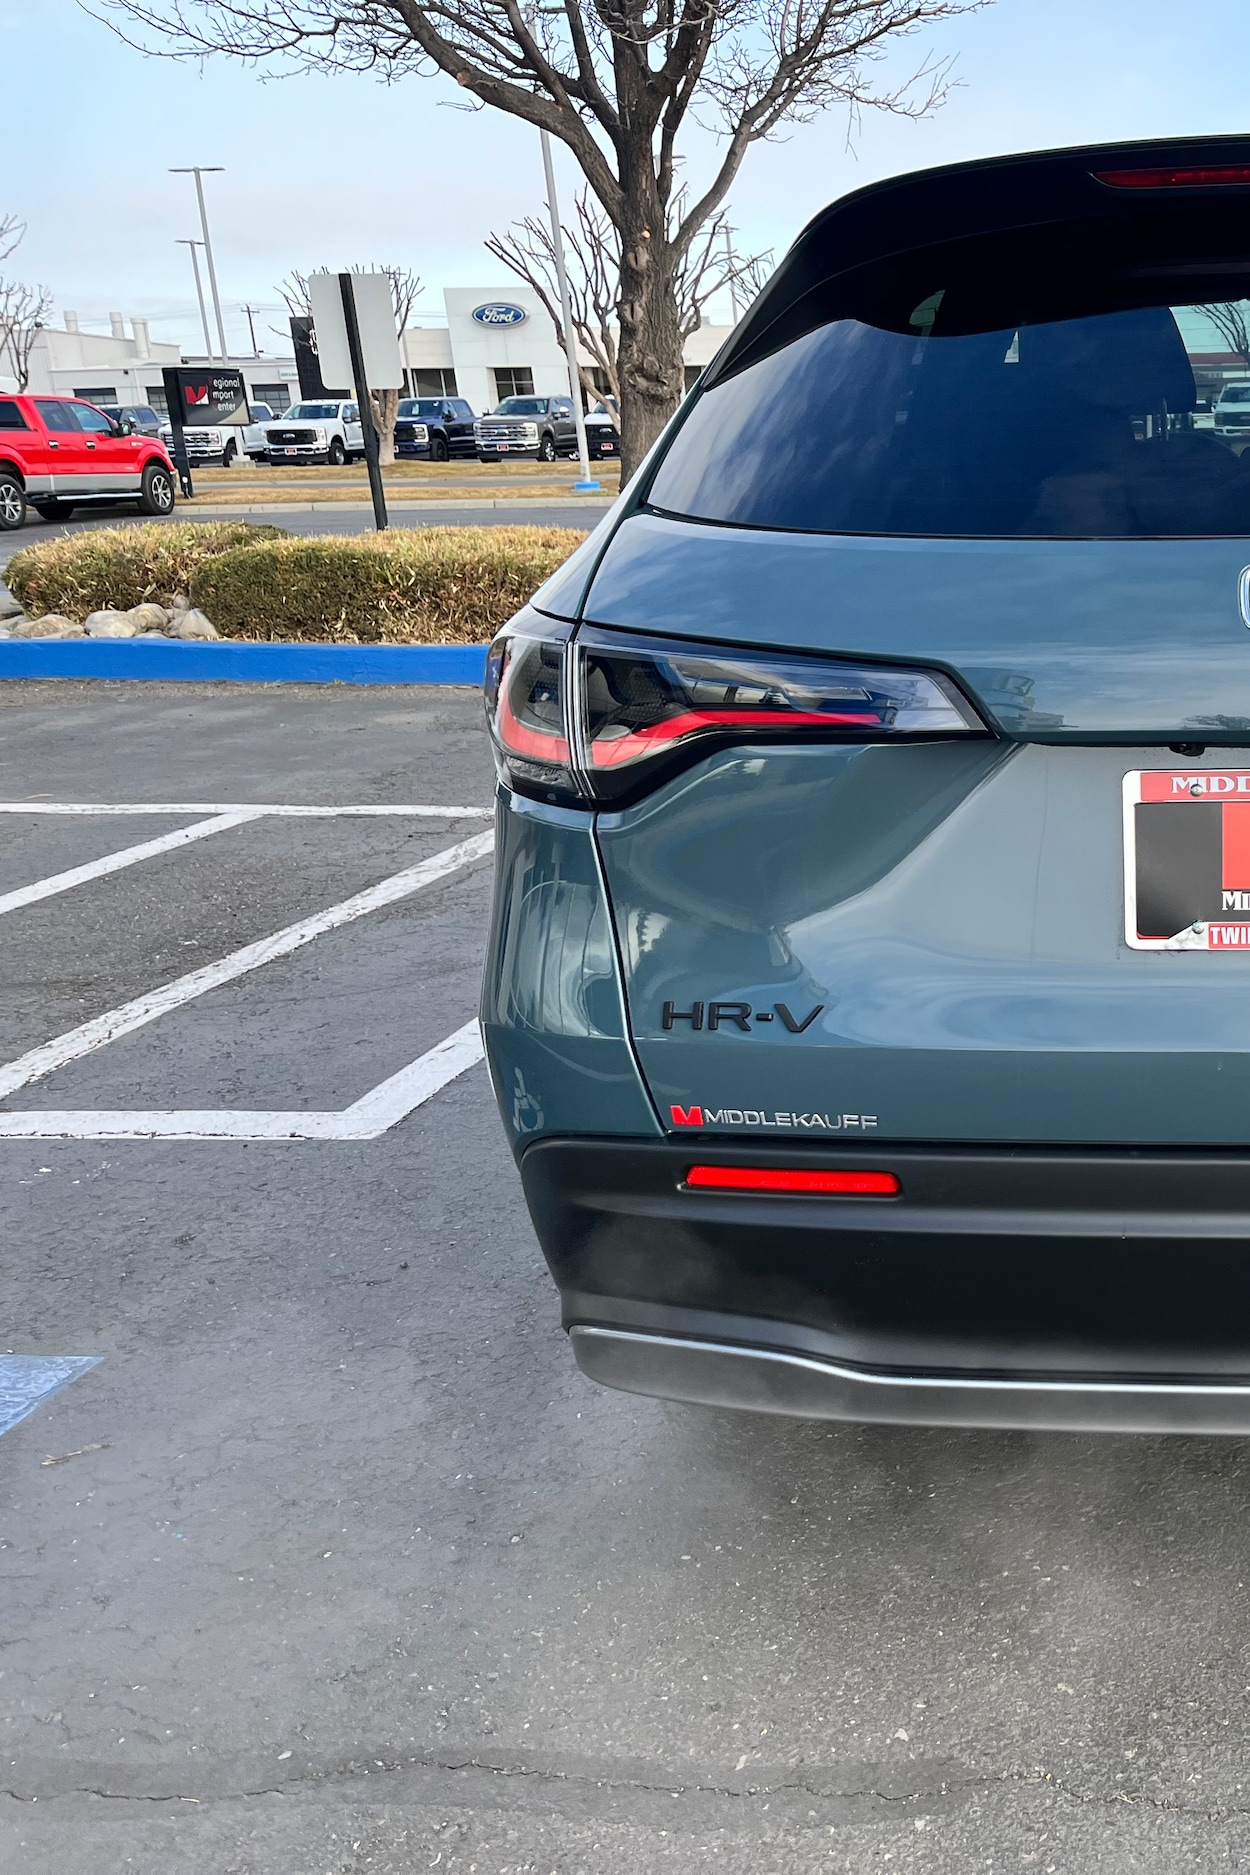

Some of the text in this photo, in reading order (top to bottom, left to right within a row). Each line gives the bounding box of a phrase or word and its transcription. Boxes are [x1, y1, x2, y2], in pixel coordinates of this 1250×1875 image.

[482, 307, 514, 322] Ford
[662, 1001, 825, 1033] HR-V
[704, 1108, 878, 1130] MIDDLEKAUFF
